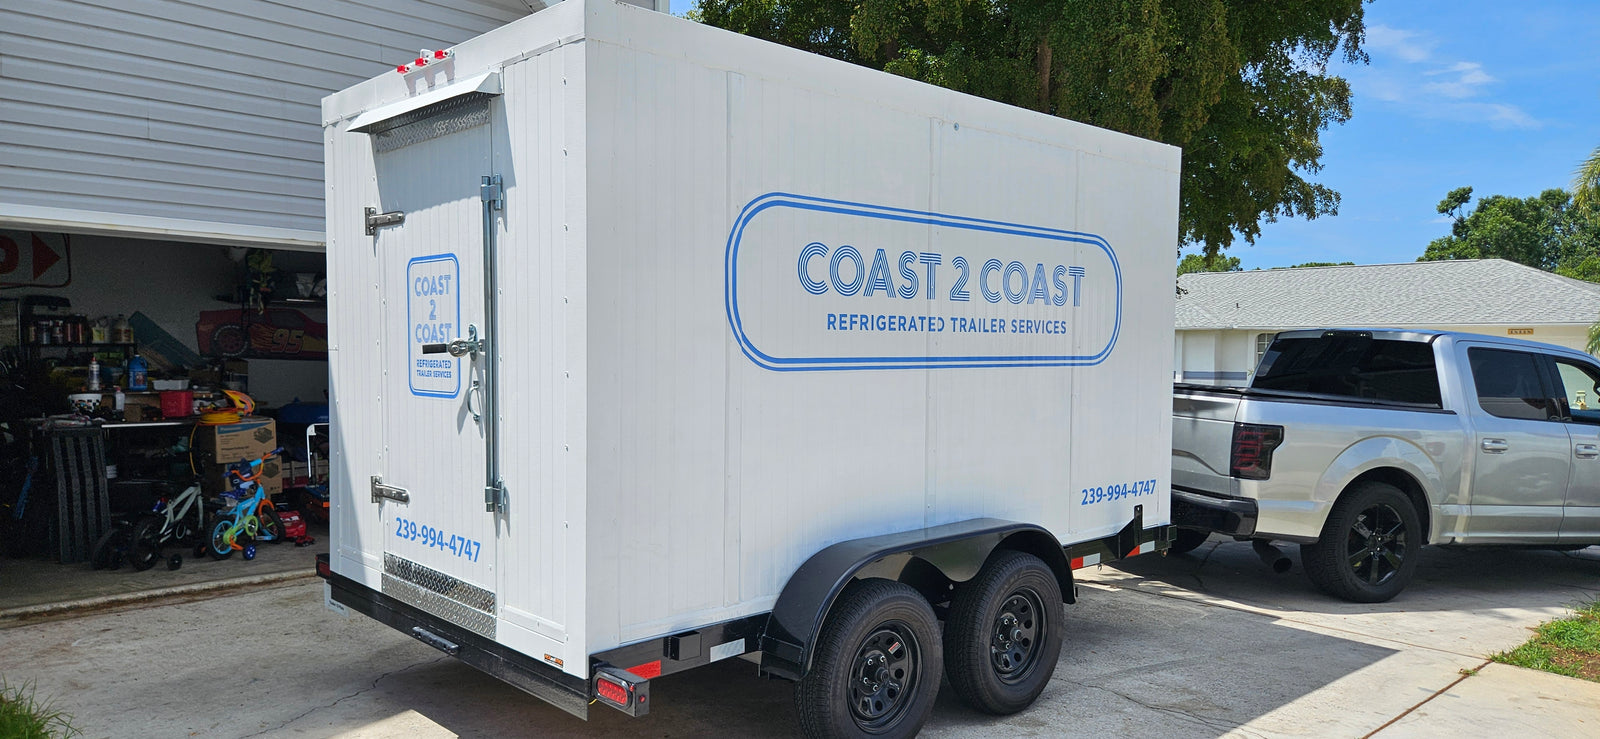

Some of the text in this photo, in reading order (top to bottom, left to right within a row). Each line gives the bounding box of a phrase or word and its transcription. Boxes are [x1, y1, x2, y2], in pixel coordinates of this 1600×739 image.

[797, 241, 1085, 307] COAST 2 COAST
[414, 274, 452, 297] COAST
[428, 299, 437, 321] 2
[415, 323, 452, 343] COAST
[827, 313, 1067, 334] REFRIGERATED TRAILER SERVICES
[271, 328, 304, 353] 95
[416, 359, 452, 369] REFRIGERATED
[416, 369, 452, 378] TRAILER SERVICES
[1081, 479, 1157, 506] 239-994-4747
[395, 516, 481, 563] 239-994-4747
